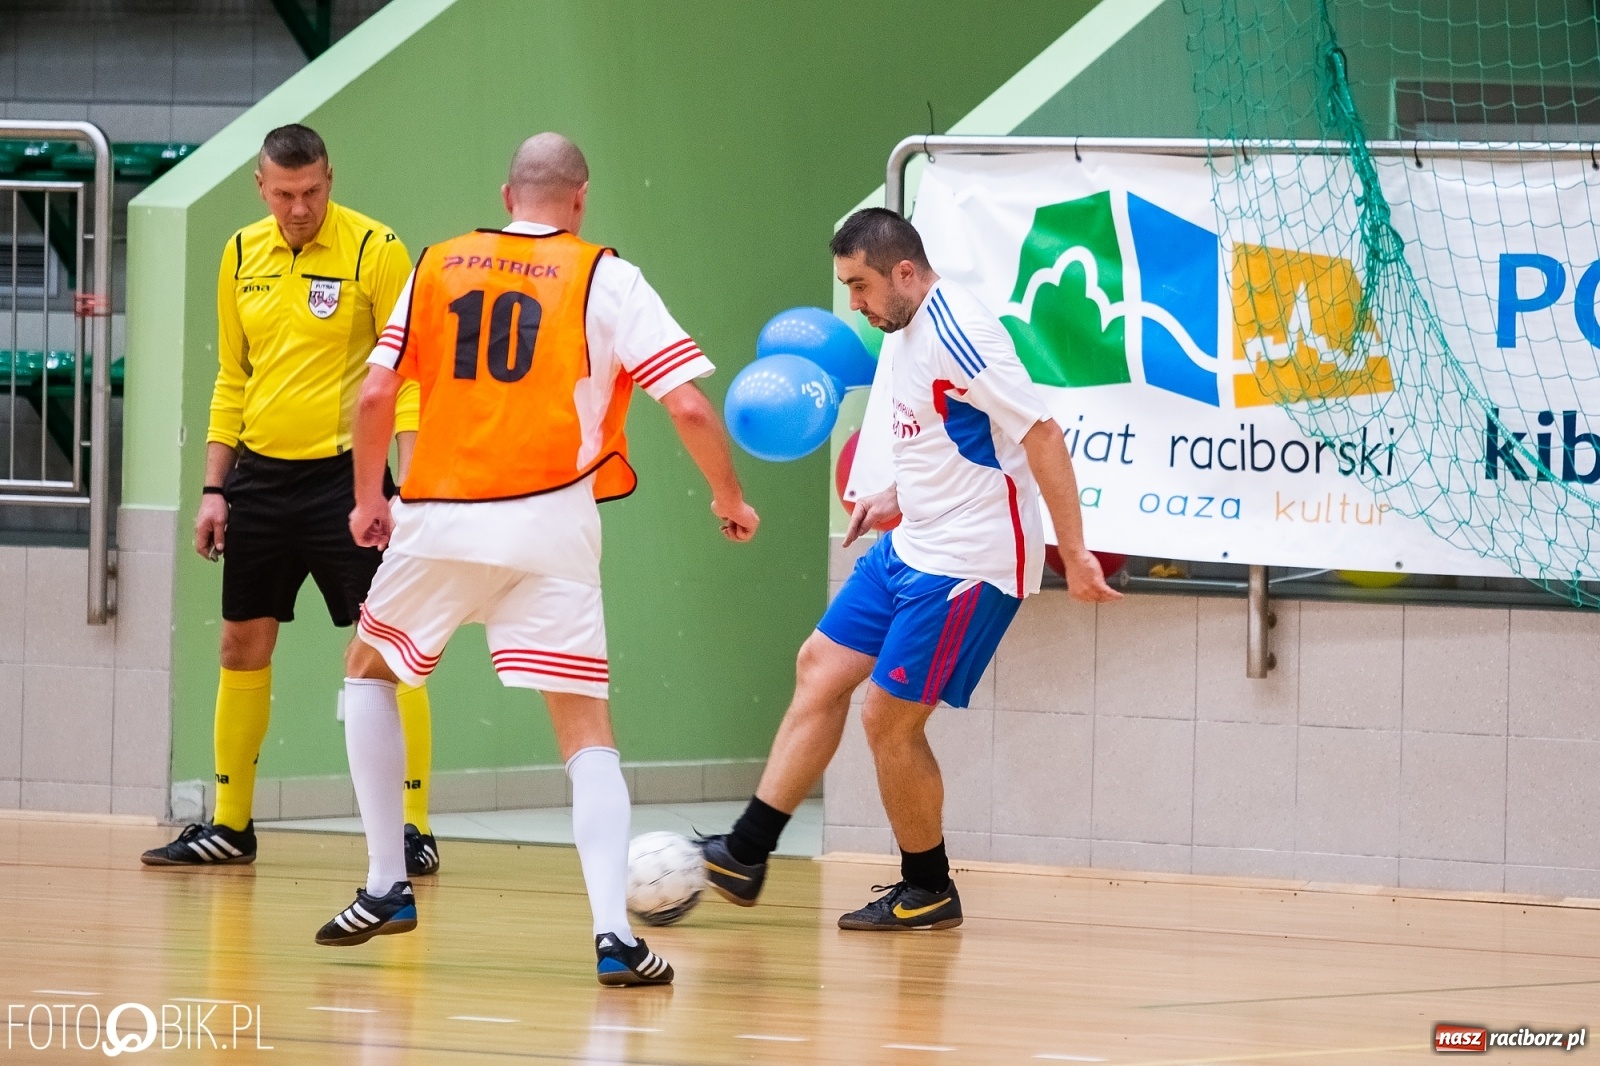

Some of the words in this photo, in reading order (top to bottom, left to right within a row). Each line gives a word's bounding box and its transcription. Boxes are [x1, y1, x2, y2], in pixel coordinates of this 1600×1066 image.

[467, 256, 561, 279] PATRICK
[448, 290, 543, 383] 10
[1063, 415, 1136, 465] iat
[1169, 423, 1396, 477] raciborski
[1139, 491, 1242, 520] oaza
